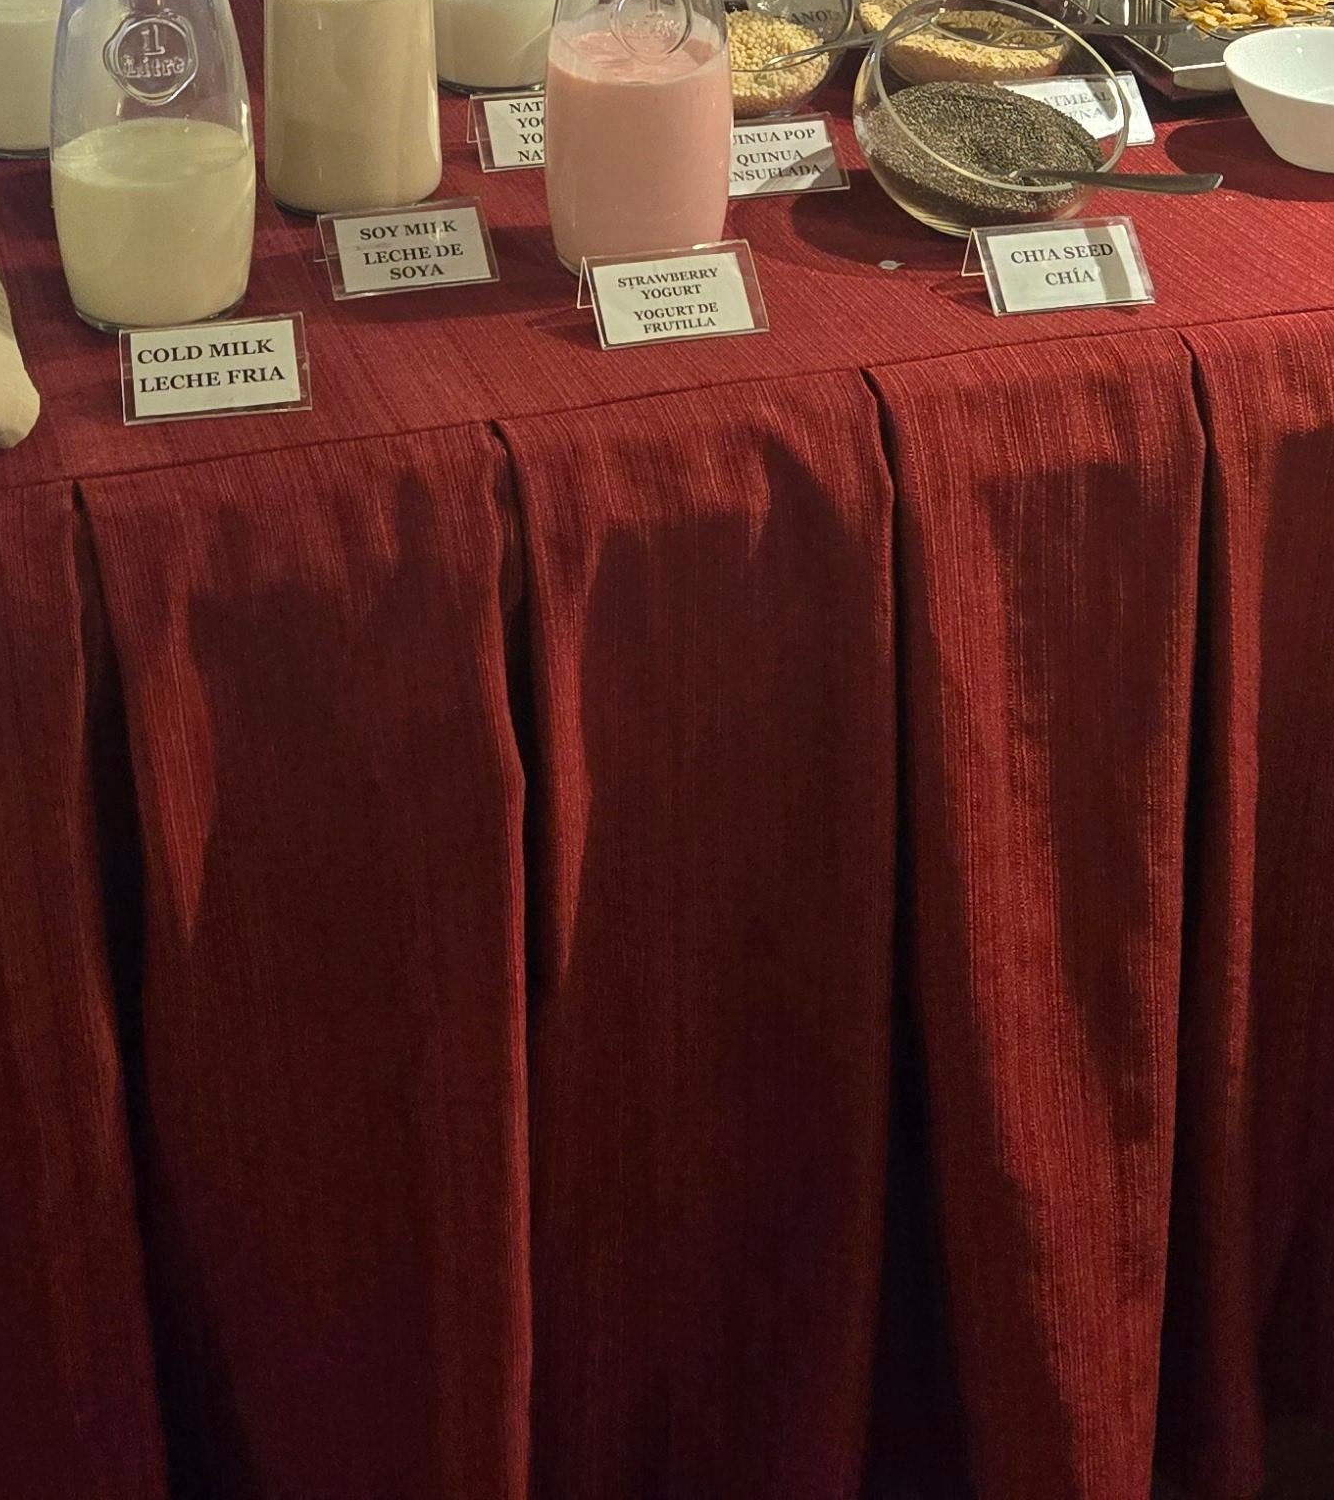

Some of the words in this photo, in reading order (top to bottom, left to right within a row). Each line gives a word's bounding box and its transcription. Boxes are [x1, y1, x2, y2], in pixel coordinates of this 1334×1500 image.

[509, 101, 544, 114] NAT
[517, 116, 544, 129] YO
[520, 132, 544, 145] YO
[783, 128, 816, 142] POP
[517, 149, 544, 162] NA
[736, 150, 805, 168] QUINUA
[730, 164, 822, 182] NSUELADA
[360, 225, 399, 241] SOY
[403, 220, 458, 236] MILK
[363, 247, 432, 265] LECHE
[435, 243, 464, 258] DE
[1010, 249, 1061, 265] CHIA
[1063, 243, 1114, 260] SEED
[389, 263, 445, 281] SOYA
[617, 267, 719, 289] STRAWBERRY
[1045, 266, 1096, 286] CHÍA
[640, 284, 702, 301] YOGURT
[633, 304, 695, 322] YOGURT
[698, 301, 720, 315] DE
[643, 316, 717, 334] FRUTILLA
[137, 345, 203, 365] COLD
[208, 338, 275, 358] MILK
[139, 371, 221, 393] LECHE
[227, 366, 285, 385] FRIA
